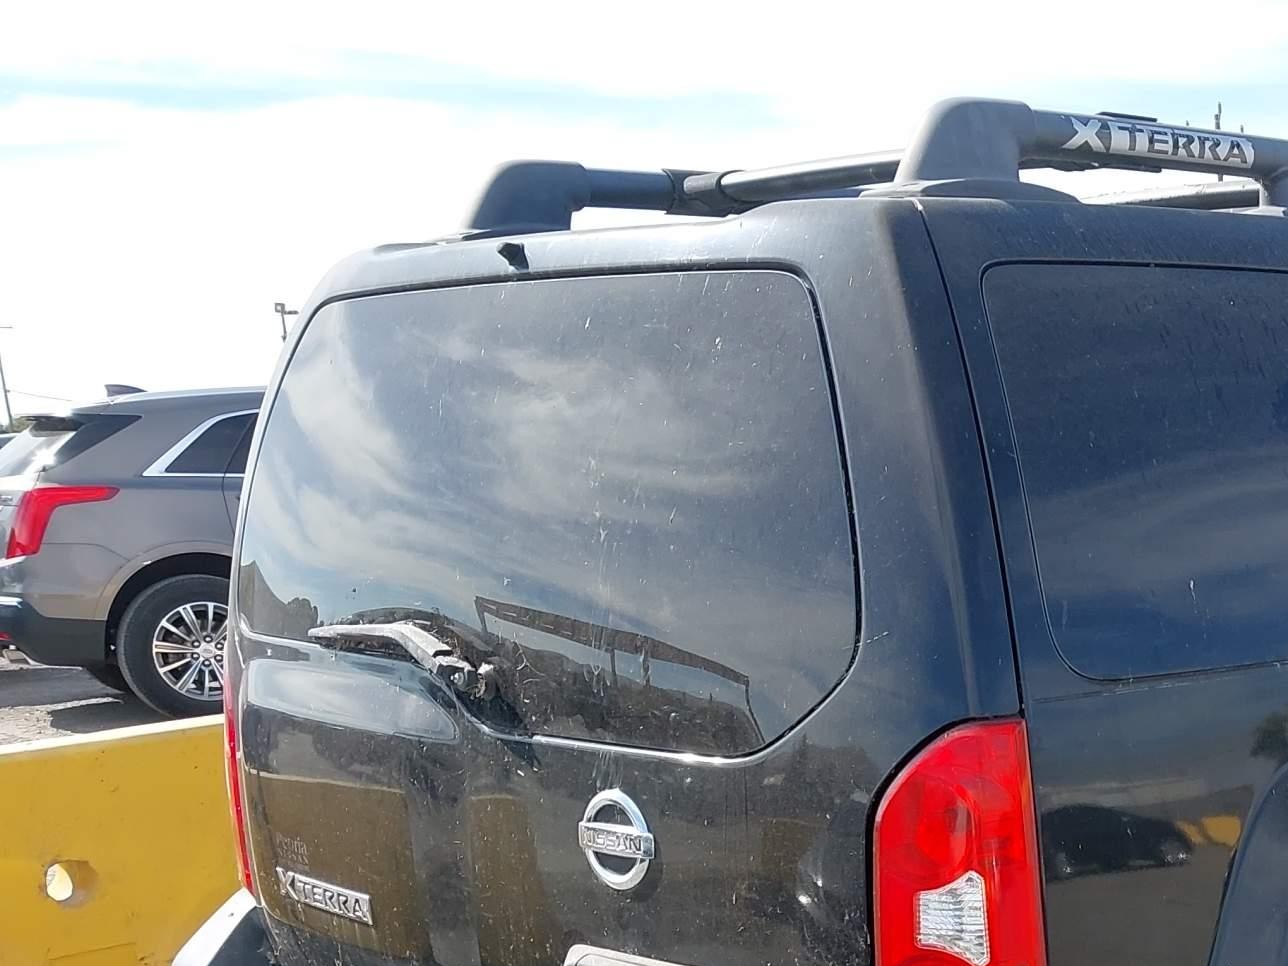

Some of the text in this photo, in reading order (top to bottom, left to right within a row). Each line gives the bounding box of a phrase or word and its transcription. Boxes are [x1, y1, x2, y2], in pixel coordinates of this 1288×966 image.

[1062, 116, 1254, 169] XTERRA
[582, 827, 643, 854] NISSAN
[276, 867, 373, 925] XTERRA
